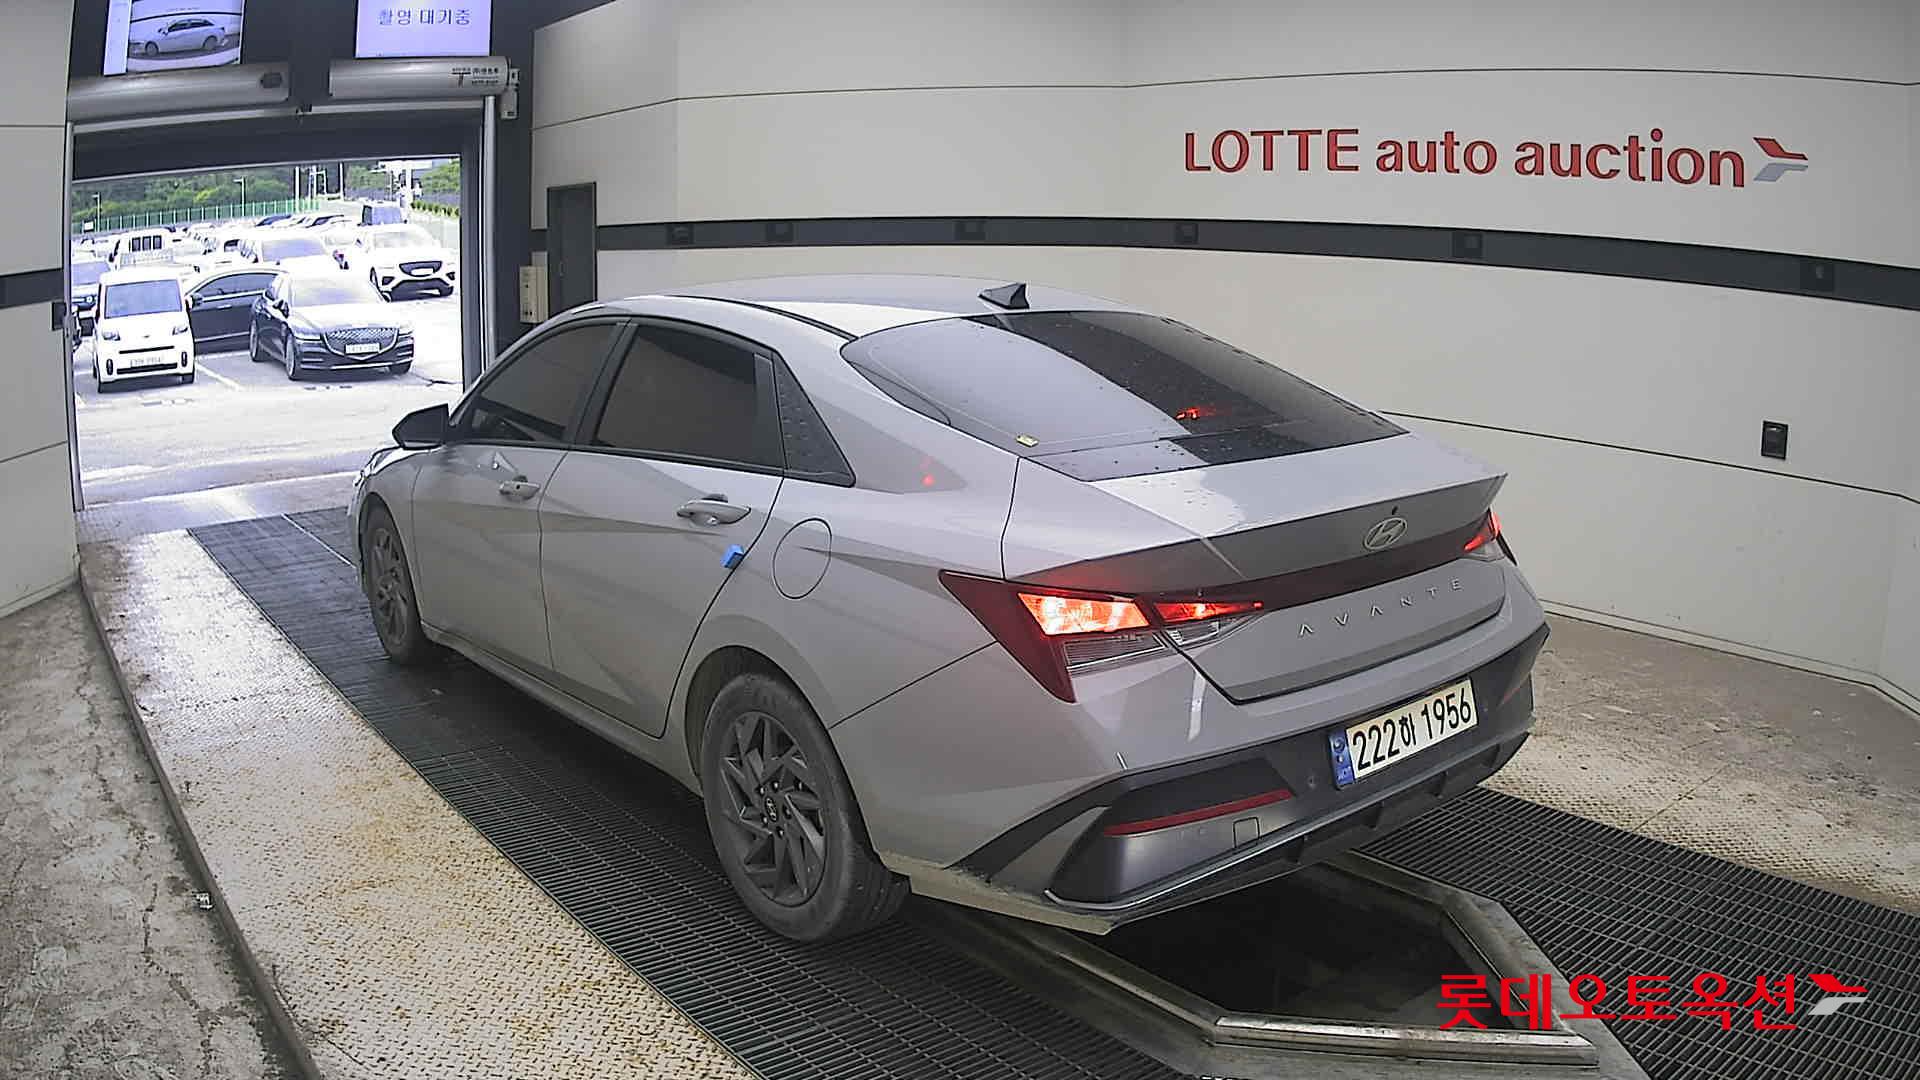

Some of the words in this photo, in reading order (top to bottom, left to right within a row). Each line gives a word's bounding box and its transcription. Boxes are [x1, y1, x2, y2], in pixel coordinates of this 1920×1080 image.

[1185, 129, 1359, 172] LOTTE
[1376, 131, 1498, 175] auto
[1514, 128, 1745, 188] auction
[1299, 577, 1462, 636] AVANTE
[1420, 687, 1473, 740] 1956
